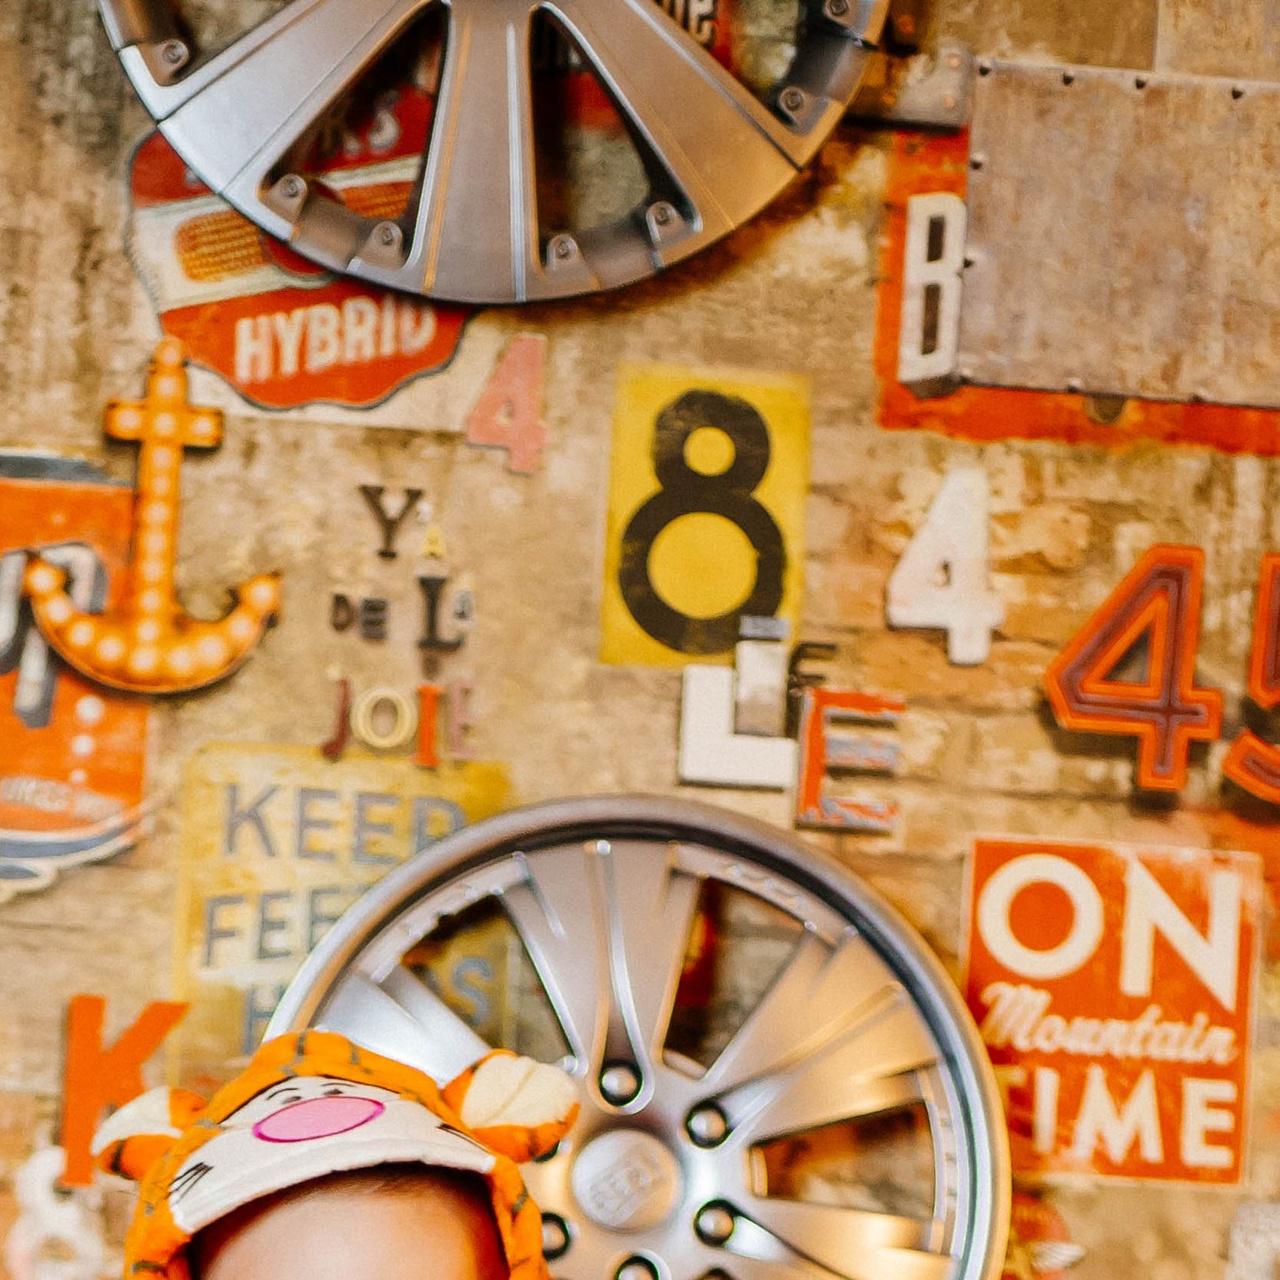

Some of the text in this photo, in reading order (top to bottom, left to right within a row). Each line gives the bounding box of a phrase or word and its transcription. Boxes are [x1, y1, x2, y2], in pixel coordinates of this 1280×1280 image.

[234, 298, 437, 384] HYBRID
[467, 333, 547, 475] 4
[618, 387, 787, 656] 8
[887, 468, 1005, 667] 4
[977, 853, 1240, 1013] ON
[980, 980, 1239, 1065] Mountain
